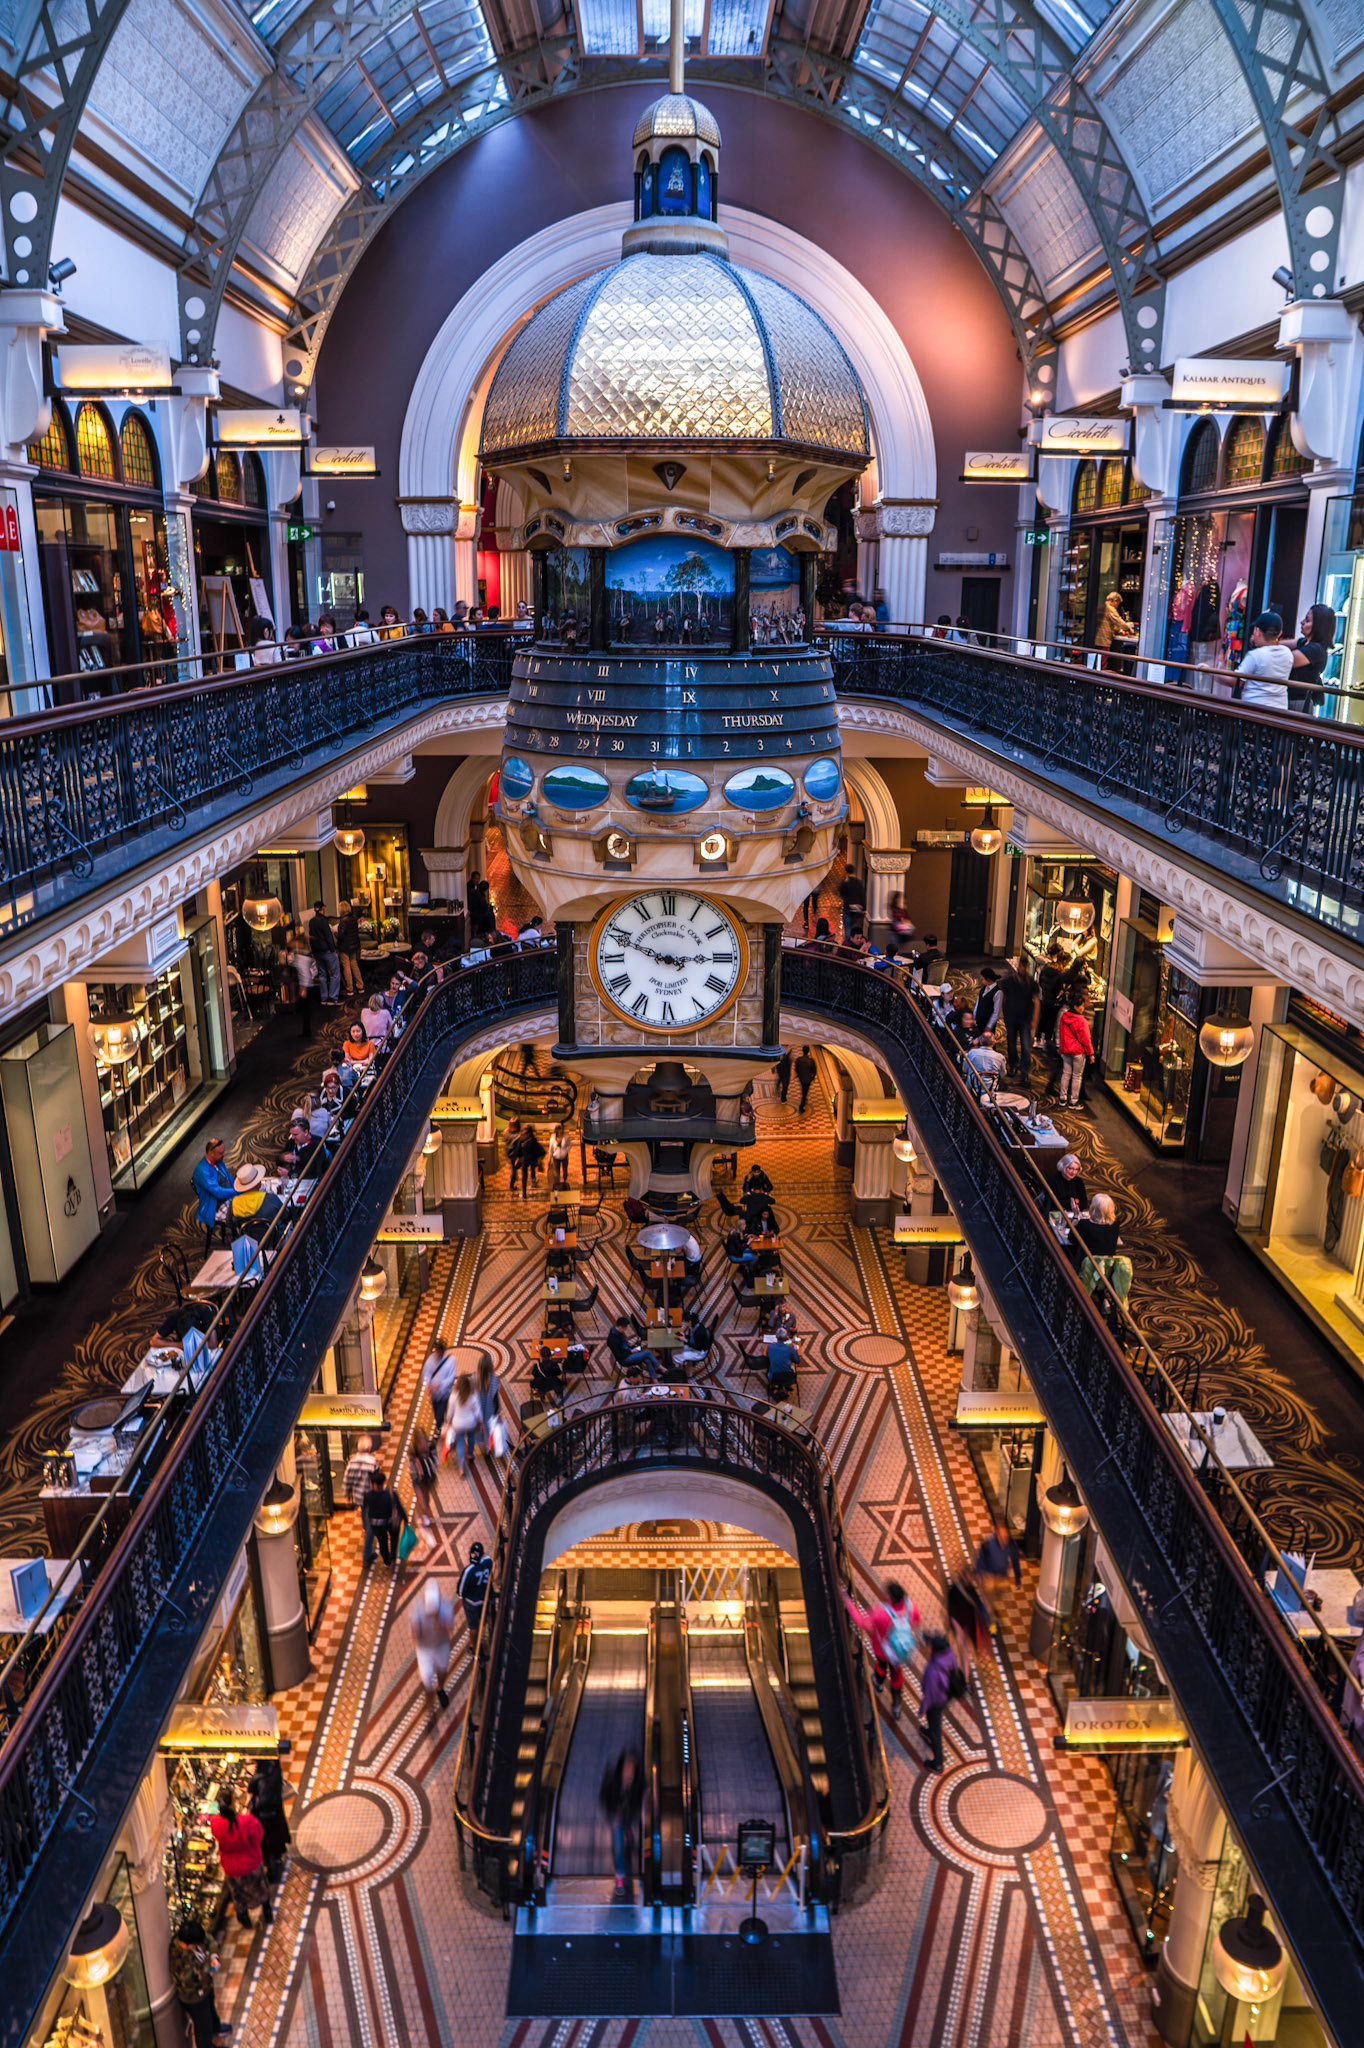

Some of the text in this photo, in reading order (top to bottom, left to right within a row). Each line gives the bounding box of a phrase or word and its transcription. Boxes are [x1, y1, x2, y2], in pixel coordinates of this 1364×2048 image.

[1182, 374, 1266, 386] KALMAR ANTIQUES
[1048, 420, 1117, 439] Cicchetti
[314, 448, 370, 464] Cicchetti
[968, 454, 1024, 469] Cicchetti
[597, 665, 610, 677] III
[685, 666, 698, 678] IV
[772, 665, 779, 676] V
[587, 689, 606, 702] VIII
[682, 691, 696, 703] IX
[770, 690, 779, 702] X
[566, 712, 638, 728] WEDNESDAY
[722, 714, 783, 728] THURSDAY
[549, 735, 559, 748] 28
[577, 738, 590, 750] 29
[611, 740, 624, 752] 30
[650, 741, 660, 752] 31
[722, 741, 730, 752] 2
[757, 739, 764, 751] 3
[786, 738, 793, 749] 4
[810, 735, 816, 746] 5
[827, 733, 832, 743] 6
[631, 901, 653, 924] XI
[660, 895, 678, 916] XII
[634, 921, 677, 947] CHRISTOPHER
[688, 929, 703, 946] COOK
[651, 929, 685, 939] Clockmaker
[704, 922, 727, 940] II
[605, 952, 625, 965] IX
[712, 951, 733, 964] III
[609, 971, 632, 997] VIII
[664, 977, 689, 989] LIMITED
[655, 988, 683, 996] SYDNEY
[630, 992, 650, 1016] VII
[662, 1001, 677, 1021] VI
[691, 996, 707, 1014] V
[201, 1729, 271, 1737] KAREN MILLEN
[1074, 1720, 1152, 1731] OROTON
